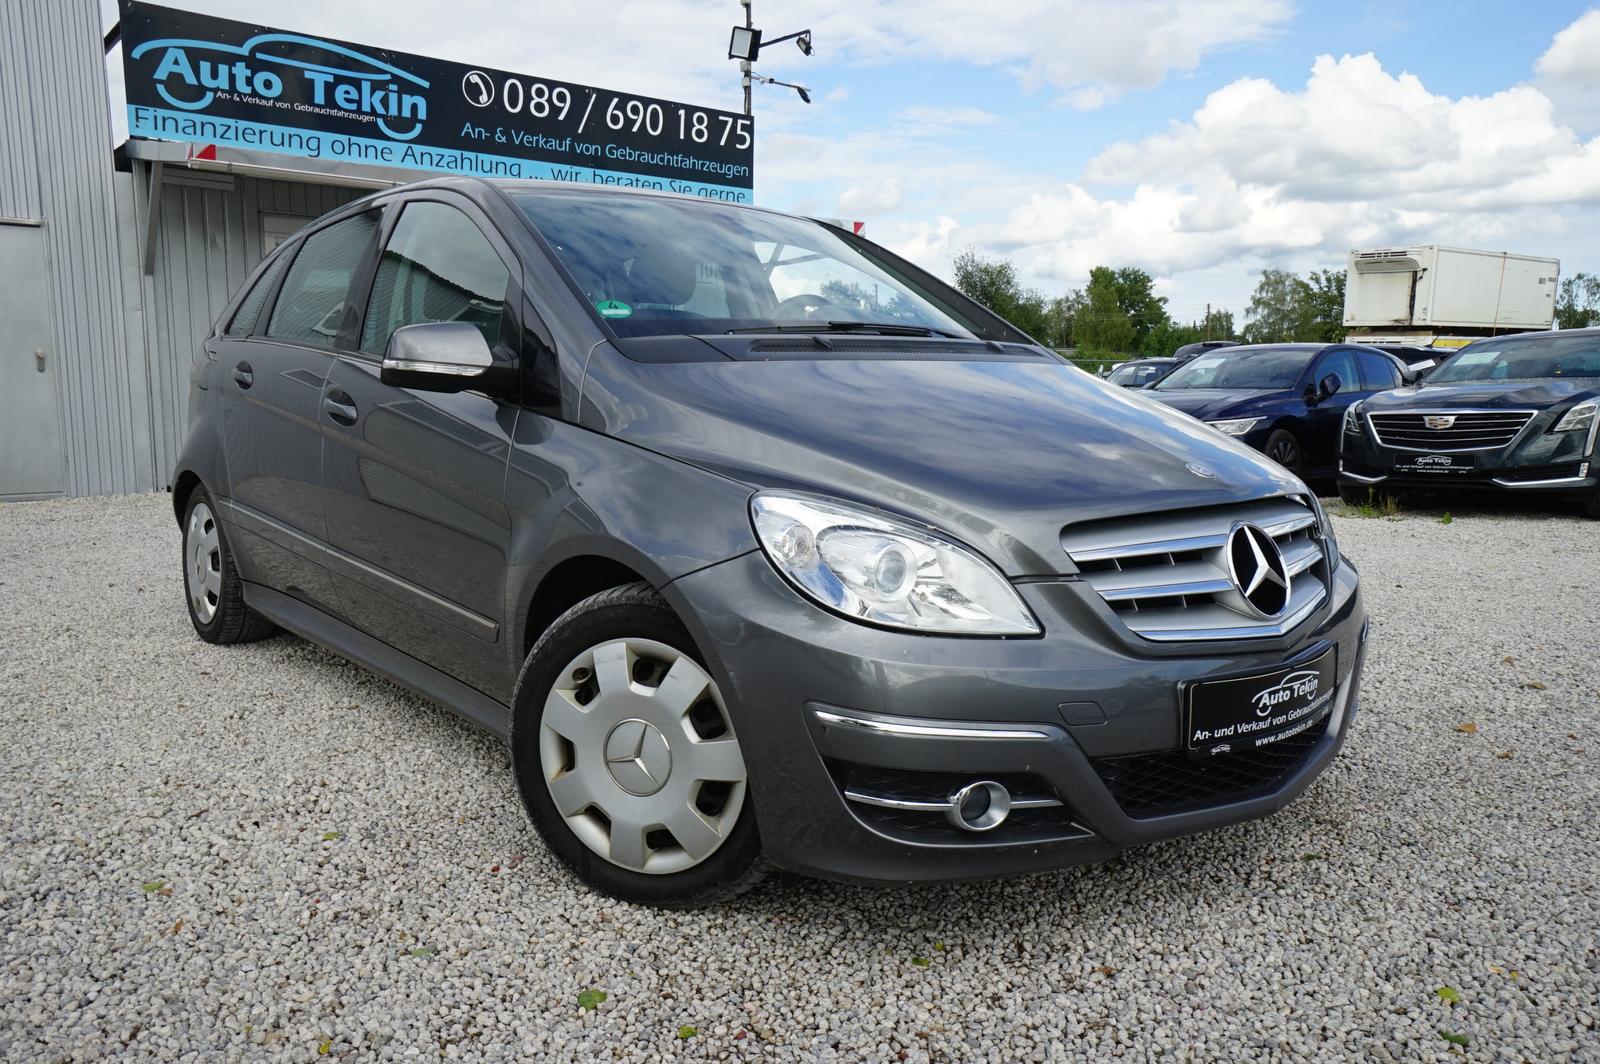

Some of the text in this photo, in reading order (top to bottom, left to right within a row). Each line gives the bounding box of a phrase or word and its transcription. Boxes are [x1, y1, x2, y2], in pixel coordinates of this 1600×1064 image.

[153, 48, 427, 120] Auto Tekin
[215, 91, 376, 123] An- & Verkauf von Gebrauchtfahrzeugen
[503, 78, 751, 150] 089 / 690 18 75
[135, 107, 321, 157] Finanzierung
[331, 137, 393, 162] ohne
[550, 167, 581, 182] wir
[461, 122, 749, 178] An- & Verkauf von Gebrauchtfahrzeugen
[608, 301, 619, 309] 4
[1258, 678, 1319, 708] Auto Tekin
[1193, 730, 1212, 741] An-
[1214, 725, 1234, 738] und
[1237, 717, 1272, 734] Verkauf
[1272, 714, 1287, 726] von
